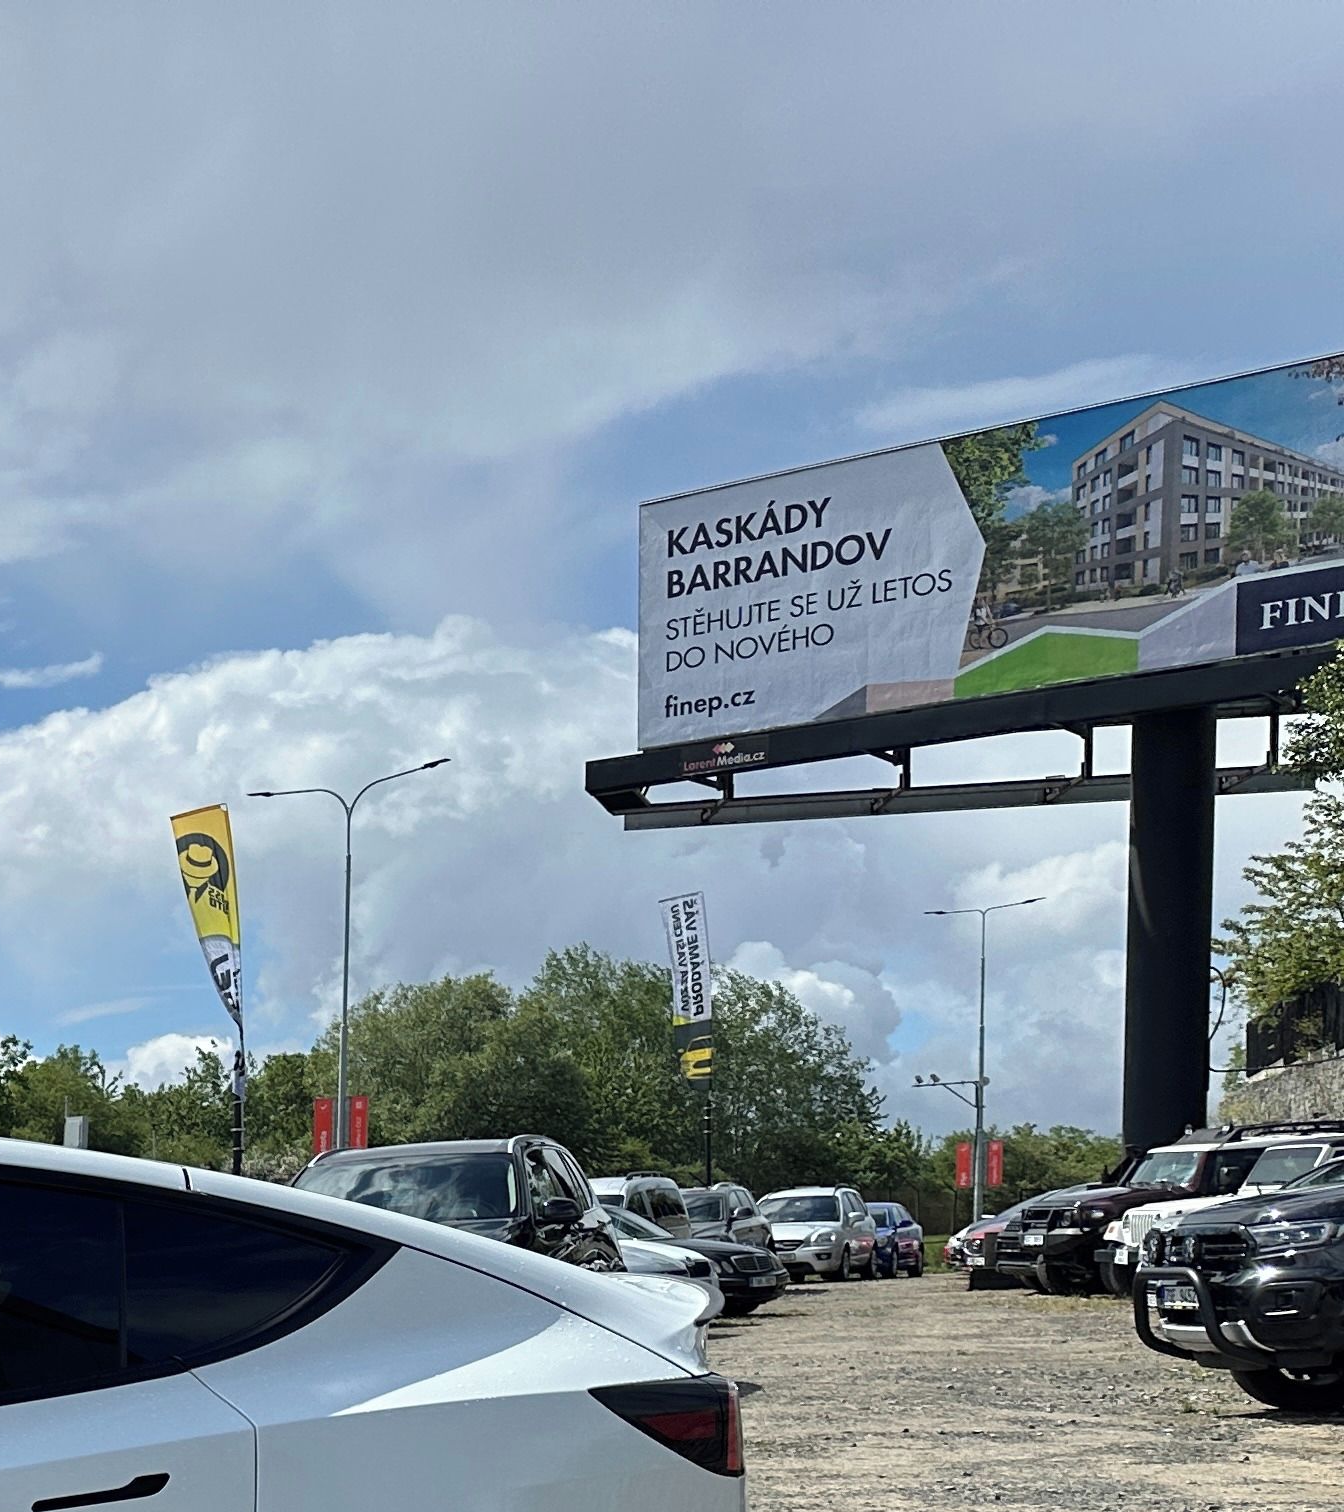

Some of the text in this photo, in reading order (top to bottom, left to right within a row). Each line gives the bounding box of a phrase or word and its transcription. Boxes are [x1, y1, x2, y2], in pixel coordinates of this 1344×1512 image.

[667, 497, 832, 558] KASKÁDY
[667, 528, 893, 599] BARRANDOV
[665, 569, 953, 641] STĚHUJTE SE UŽ LETOS
[665, 623, 835, 673] DO NOVÉHO
[664, 687, 756, 720] finep.cz
